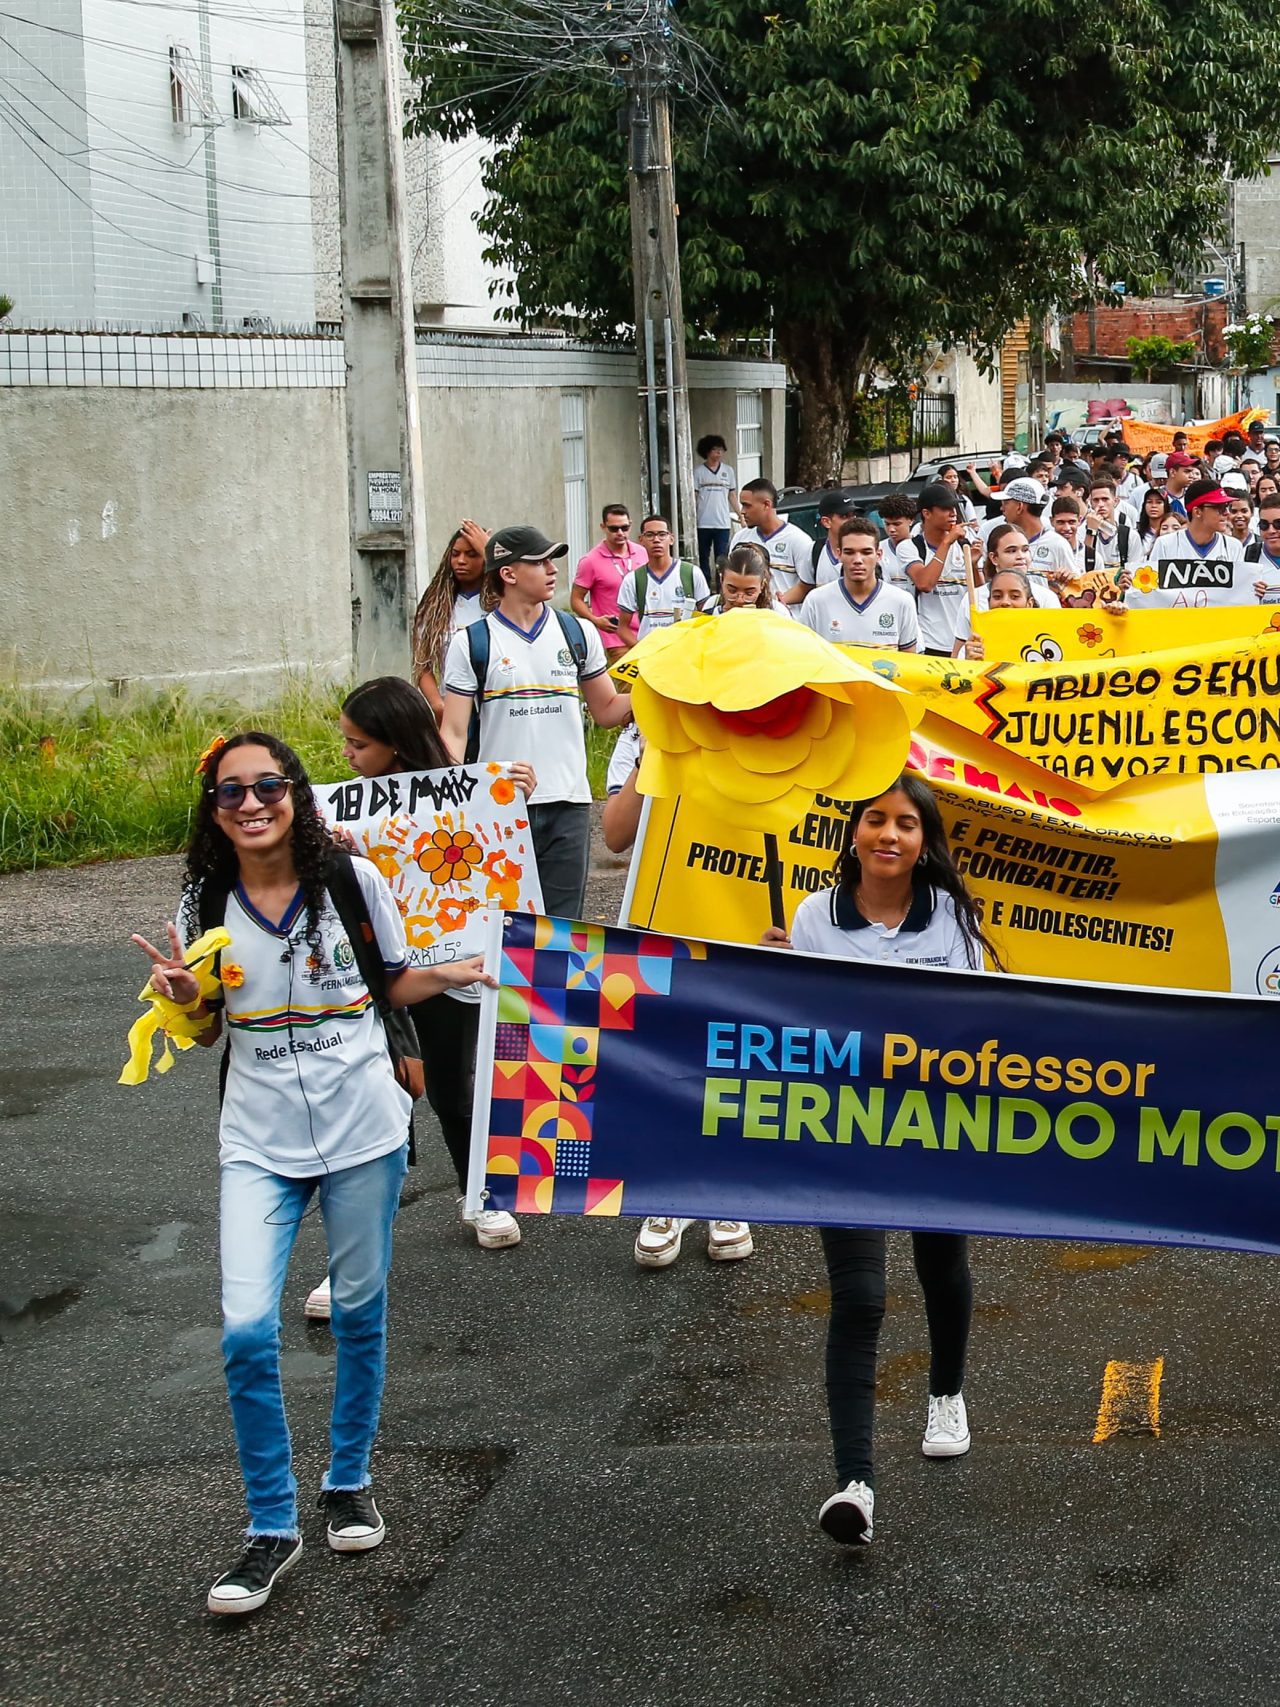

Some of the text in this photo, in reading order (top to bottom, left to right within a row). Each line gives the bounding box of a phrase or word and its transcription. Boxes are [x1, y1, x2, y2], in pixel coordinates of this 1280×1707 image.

[1163, 560, 1231, 589] NÃO
[1026, 667, 1161, 702] ABUSO
[509, 704, 563, 718] Rede Estadual
[1005, 709, 1155, 747] JUVENIL
[327, 783, 364, 822] 18
[368, 777, 403, 817] DE
[963, 763, 1083, 818] MAIO
[964, 797, 1027, 818] ABUSO
[1030, 812, 1042, 821] E
[1047, 816, 1173, 844] EXPLORAÇÃO
[950, 818, 1120, 880] É PERMITIR,
[951, 846, 1122, 902] COMBATER!
[991, 900, 1004, 927] E
[1009, 903, 1175, 953] ADOLESCENTES!
[407, 944, 440, 966] ART
[255, 1045, 287, 1061] Rede
[706, 1021, 1156, 1097] EREM Professor
[702, 1076, 1116, 1161] FERNANDO
